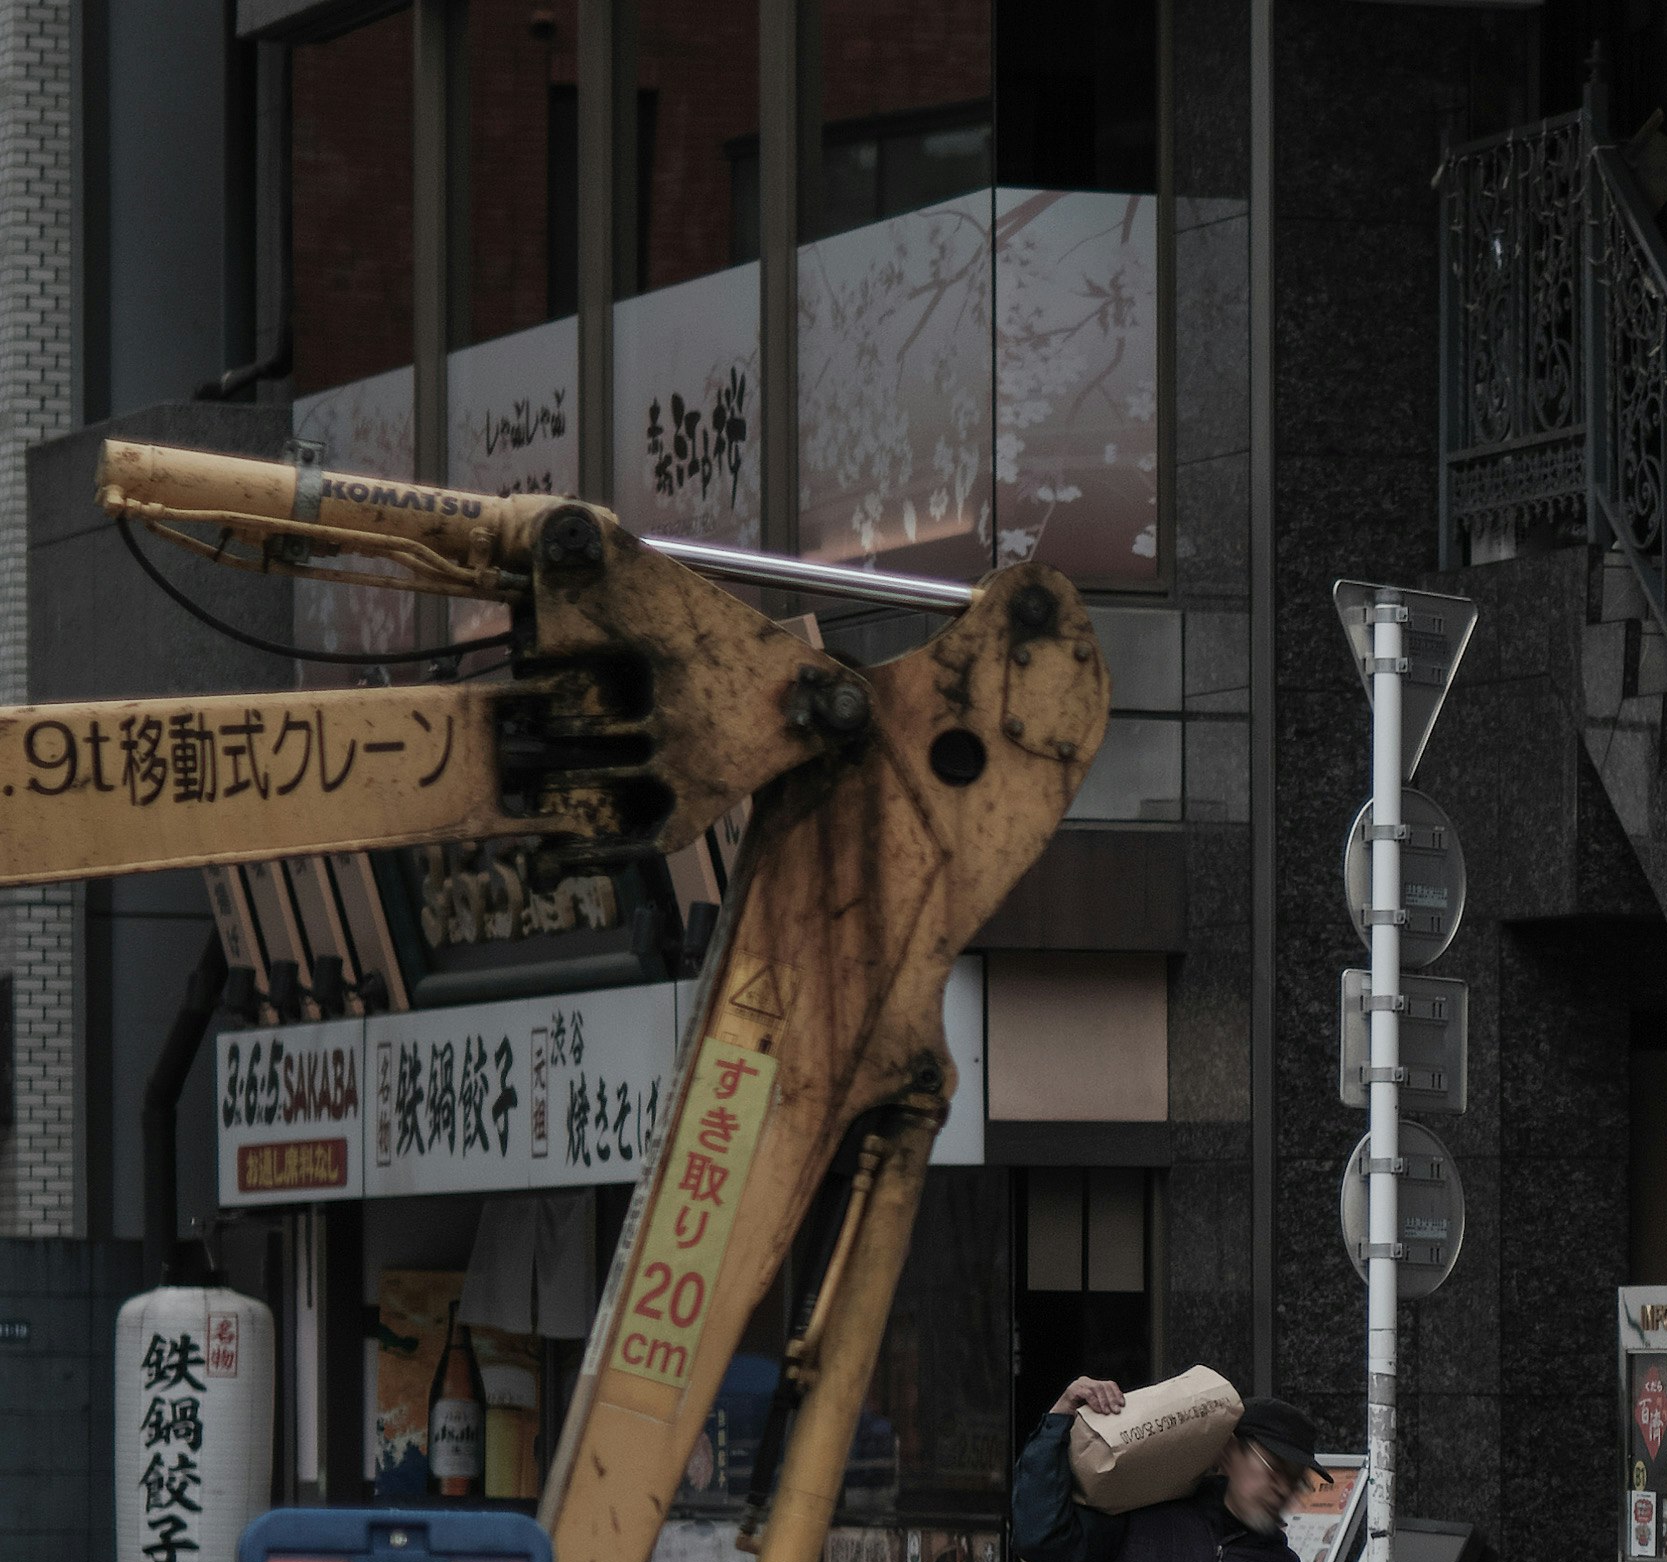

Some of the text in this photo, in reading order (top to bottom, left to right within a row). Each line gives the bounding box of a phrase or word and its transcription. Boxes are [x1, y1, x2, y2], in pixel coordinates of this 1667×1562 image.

[322, 477, 482, 519] KOMATSU
[549, 1011, 585, 1068] 渋谷
[395, 1032, 518, 1158] 鉄鍋餃子
[244, 1145, 340, 1189] お通し席料なし
[674, 1056, 758, 1250] すき取り
[633, 1261, 705, 1329] 20
[212, 1318, 237, 1371] 名物
[621, 1332, 688, 1378] cm
